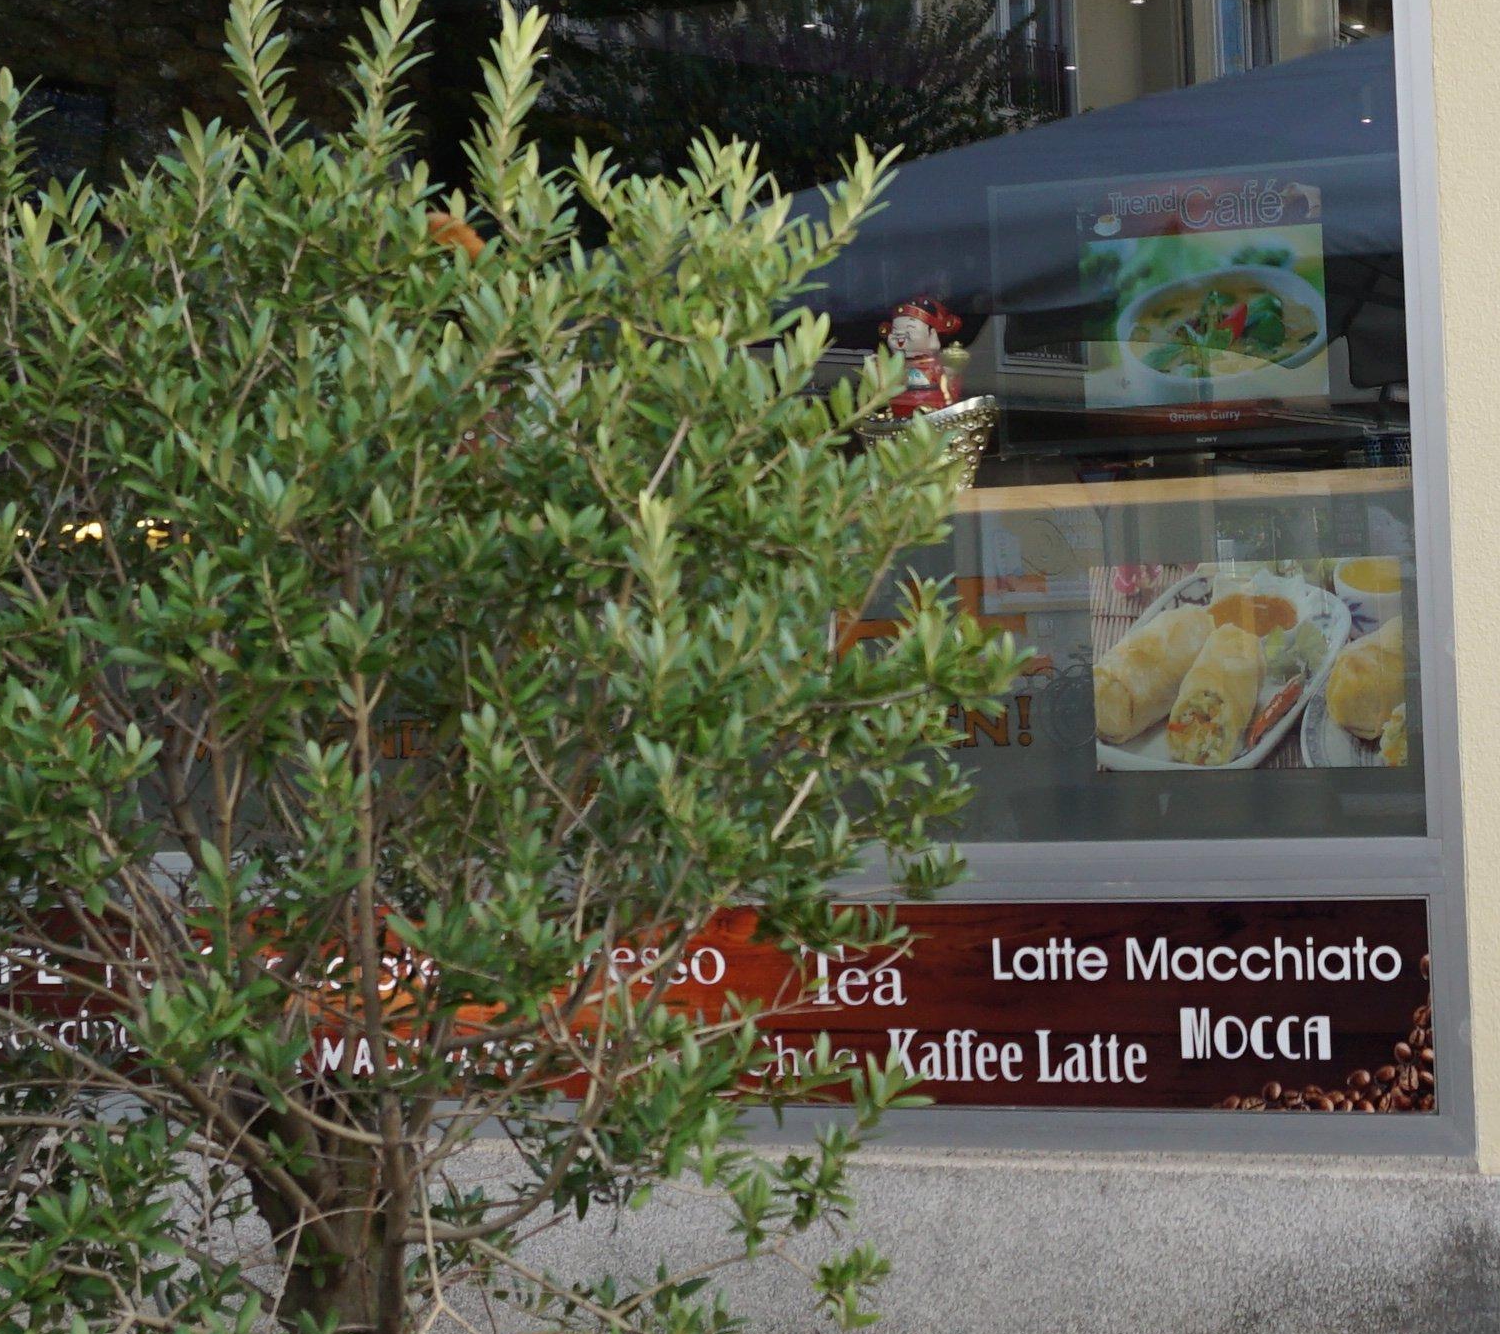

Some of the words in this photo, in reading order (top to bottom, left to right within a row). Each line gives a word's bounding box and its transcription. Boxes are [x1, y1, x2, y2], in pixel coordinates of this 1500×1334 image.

[1108, 186, 1177, 218] Trend
[1180, 178, 1283, 229] Café
[800, 942, 908, 1008] Tea
[992, 935, 1109, 982] Latte
[1126, 935, 1403, 983] Macchiato
[886, 1027, 1024, 1082] Kaffee
[1037, 1028, 1148, 1084] Latte
